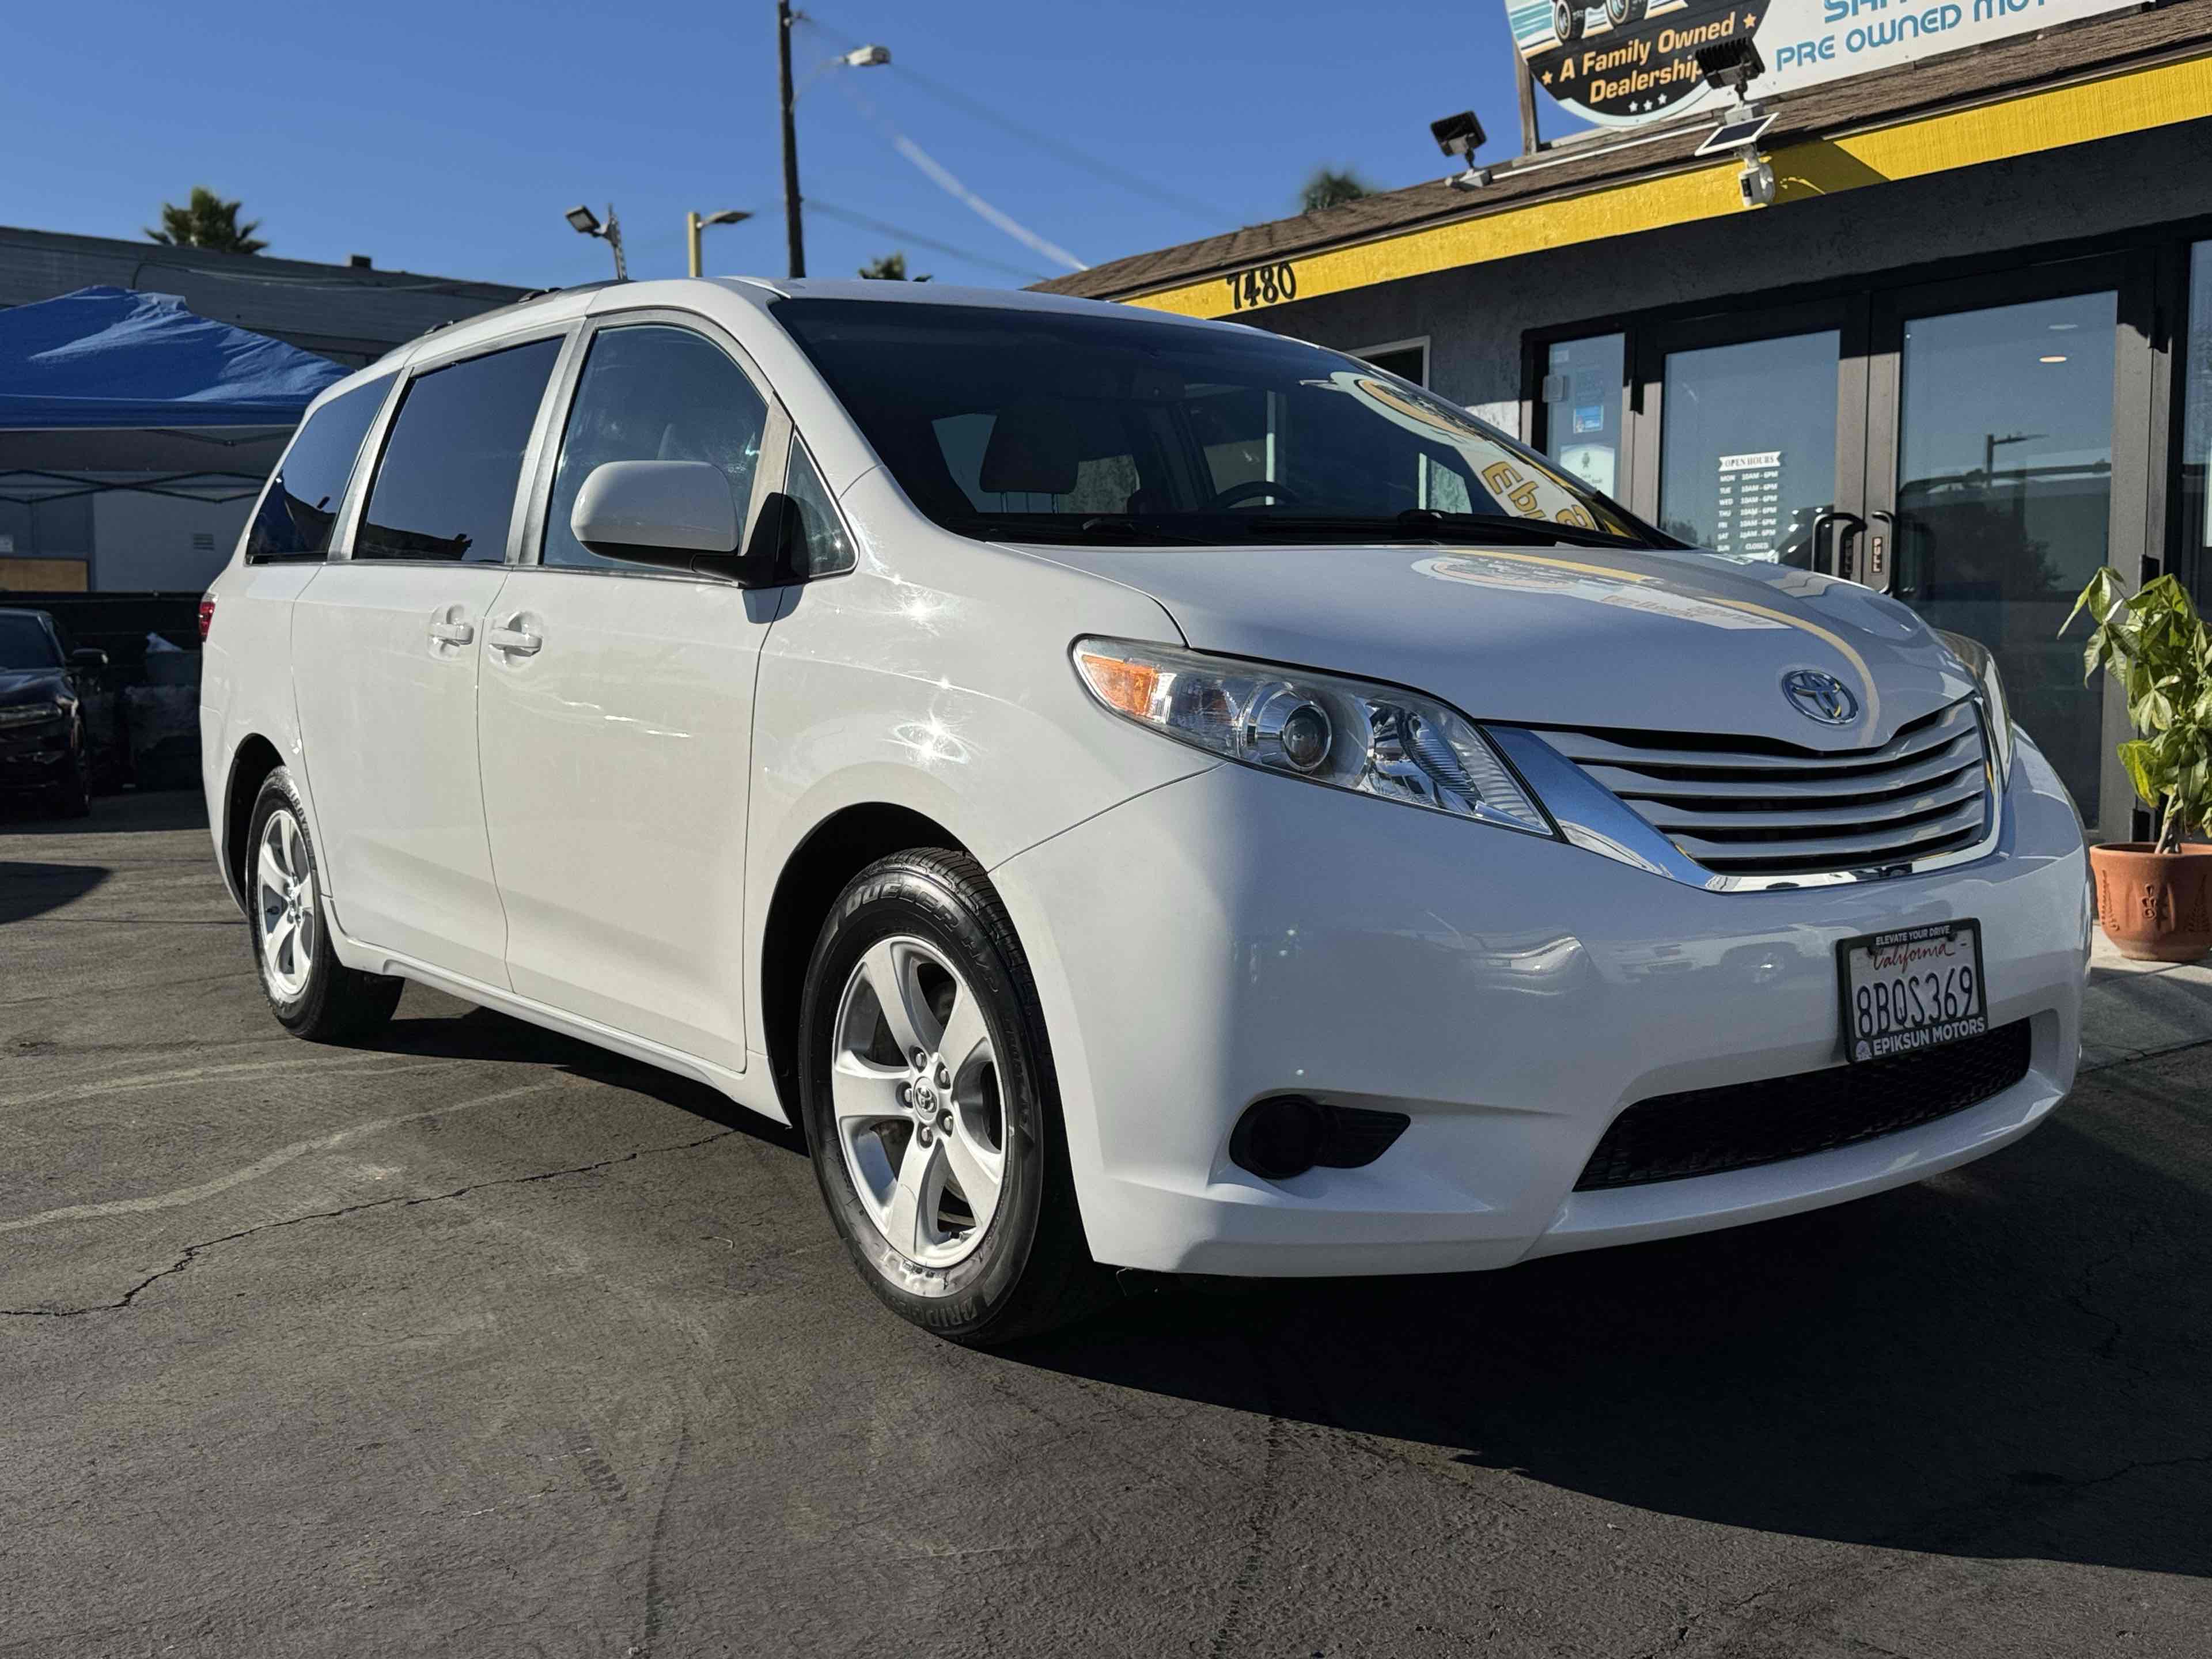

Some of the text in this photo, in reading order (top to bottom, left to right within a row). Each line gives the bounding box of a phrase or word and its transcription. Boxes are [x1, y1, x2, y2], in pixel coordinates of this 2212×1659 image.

[1559, 12, 1736, 83] A Family Owned
[1775, 35, 1835, 72] PRE
[1845, 3, 1962, 53] OWNED
[1226, 261, 1297, 310] 7480
[1725, 455, 1774, 467] OPEN HOURS
[1873, 537, 1881, 572] PULL
[1875, 925, 1950, 946] ELEVATE YOUR DRIVE
[1872, 942, 1956, 974] California
[1856, 965, 1974, 1038] 8BQS369
[1873, 1016, 1986, 1056] EPIKSUN MOTORS
